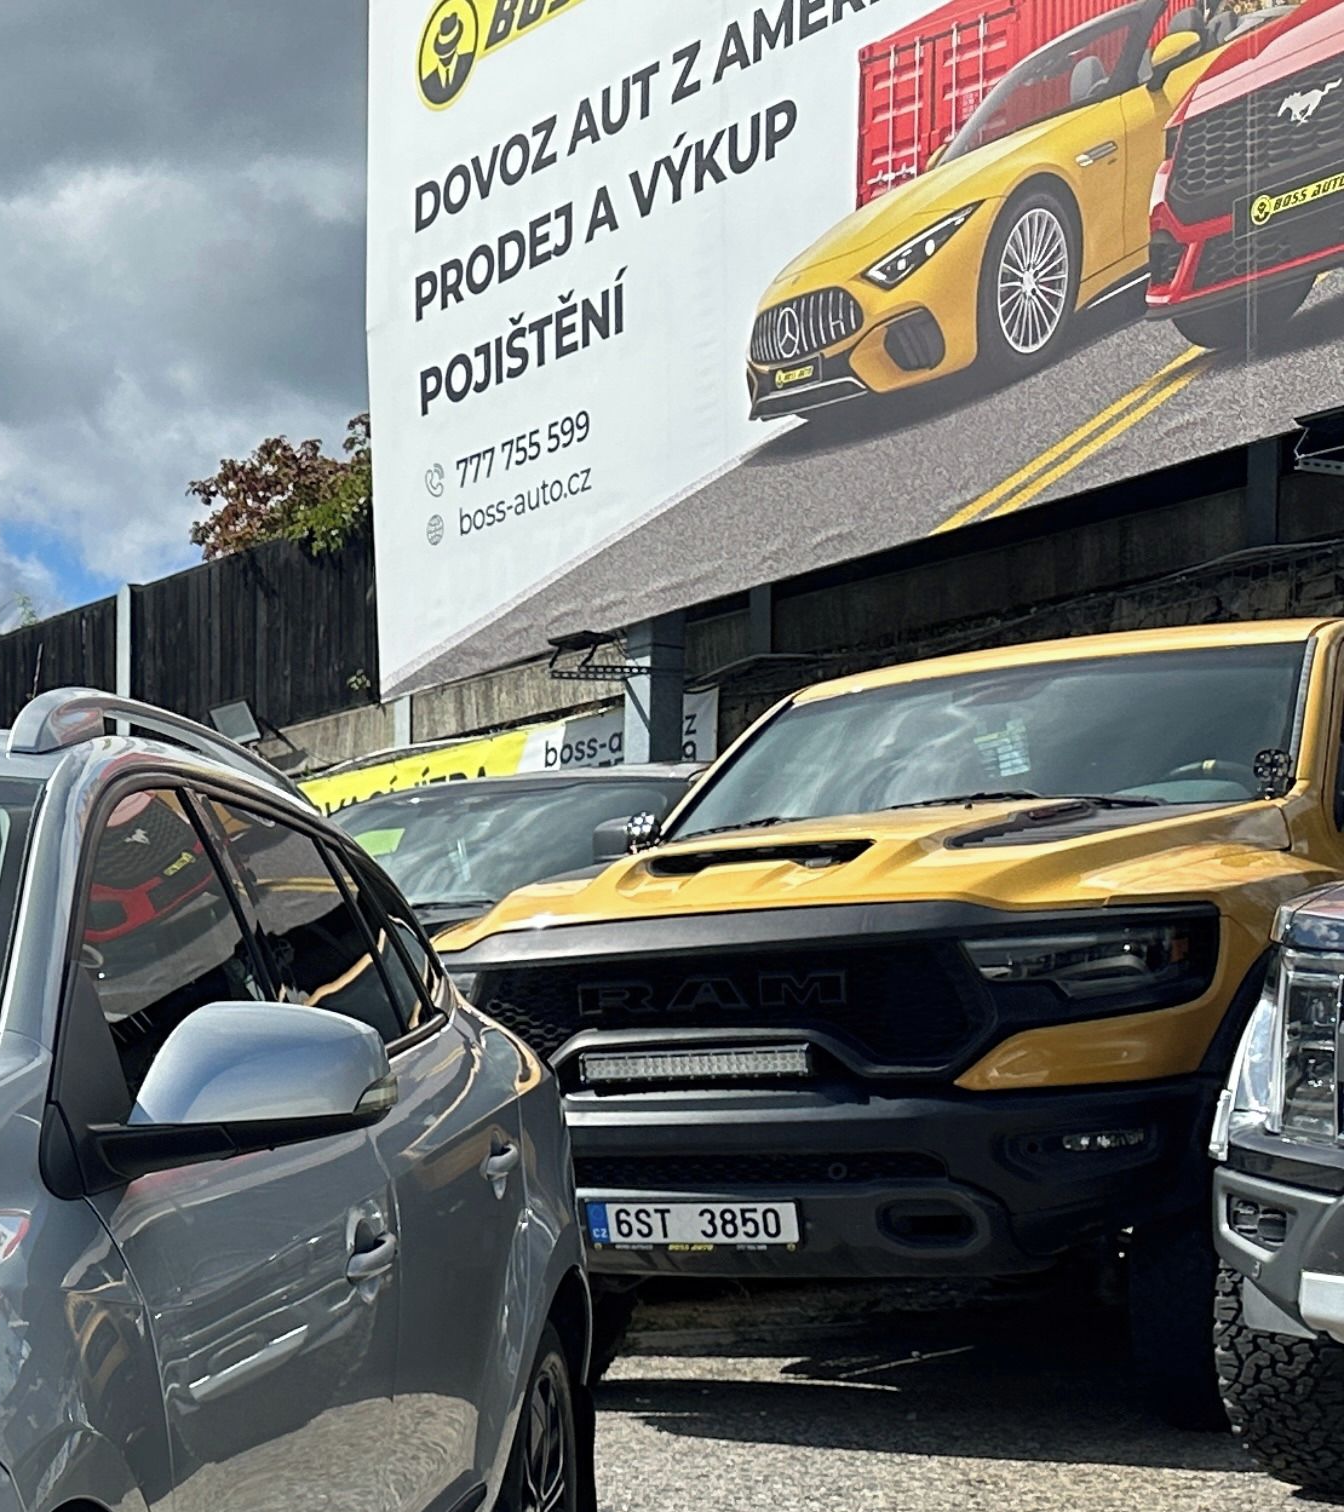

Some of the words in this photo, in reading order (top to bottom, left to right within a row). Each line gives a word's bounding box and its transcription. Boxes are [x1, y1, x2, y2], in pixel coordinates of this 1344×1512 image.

[415, 114, 558, 233] DOVOZ
[567, 61, 660, 156] AUT
[671, 39, 701, 105] Z
[415, 201, 574, 322] PRODEJ
[584, 184, 619, 244] A
[628, 99, 798, 218] VÝKUP
[420, 265, 628, 416] POJIŠTĚNÍ
[456, 446, 495, 488] 777
[501, 429, 541, 470] 755
[547, 410, 590, 453] 599
[459, 467, 592, 536] boss-auto.cz
[577, 970, 846, 1017] RAM
[592, 1228, 608, 1239] CZ
[615, 1208, 671, 1239] 6ST
[698, 1208, 782, 1239] 3850
